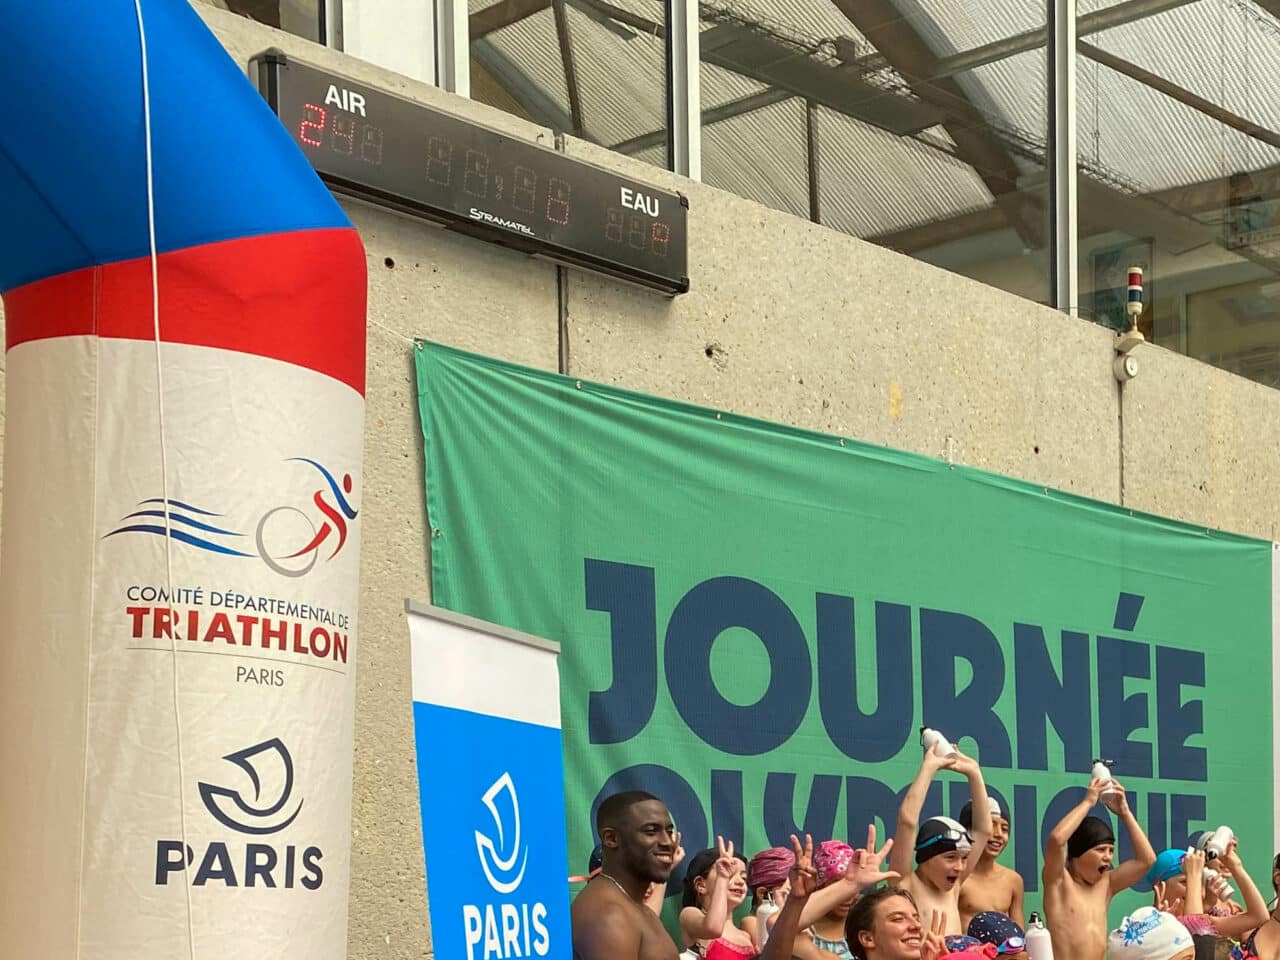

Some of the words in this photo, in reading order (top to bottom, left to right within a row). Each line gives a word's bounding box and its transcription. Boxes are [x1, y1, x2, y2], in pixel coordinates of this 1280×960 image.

[325, 84, 366, 117] AIR
[620, 187, 659, 217] EAU
[469, 207, 536, 236] STRAMATEL
[126, 586, 204, 606] COMITÉ
[210, 589, 337, 627] DÉPARTEMENTAL
[338, 613, 349, 630] DE
[126, 606, 348, 664] TRIATHLON
[236, 666, 285, 687] PARIS
[584, 557, 1208, 782] JOURNÉE
[155, 840, 324, 890] PARIS
